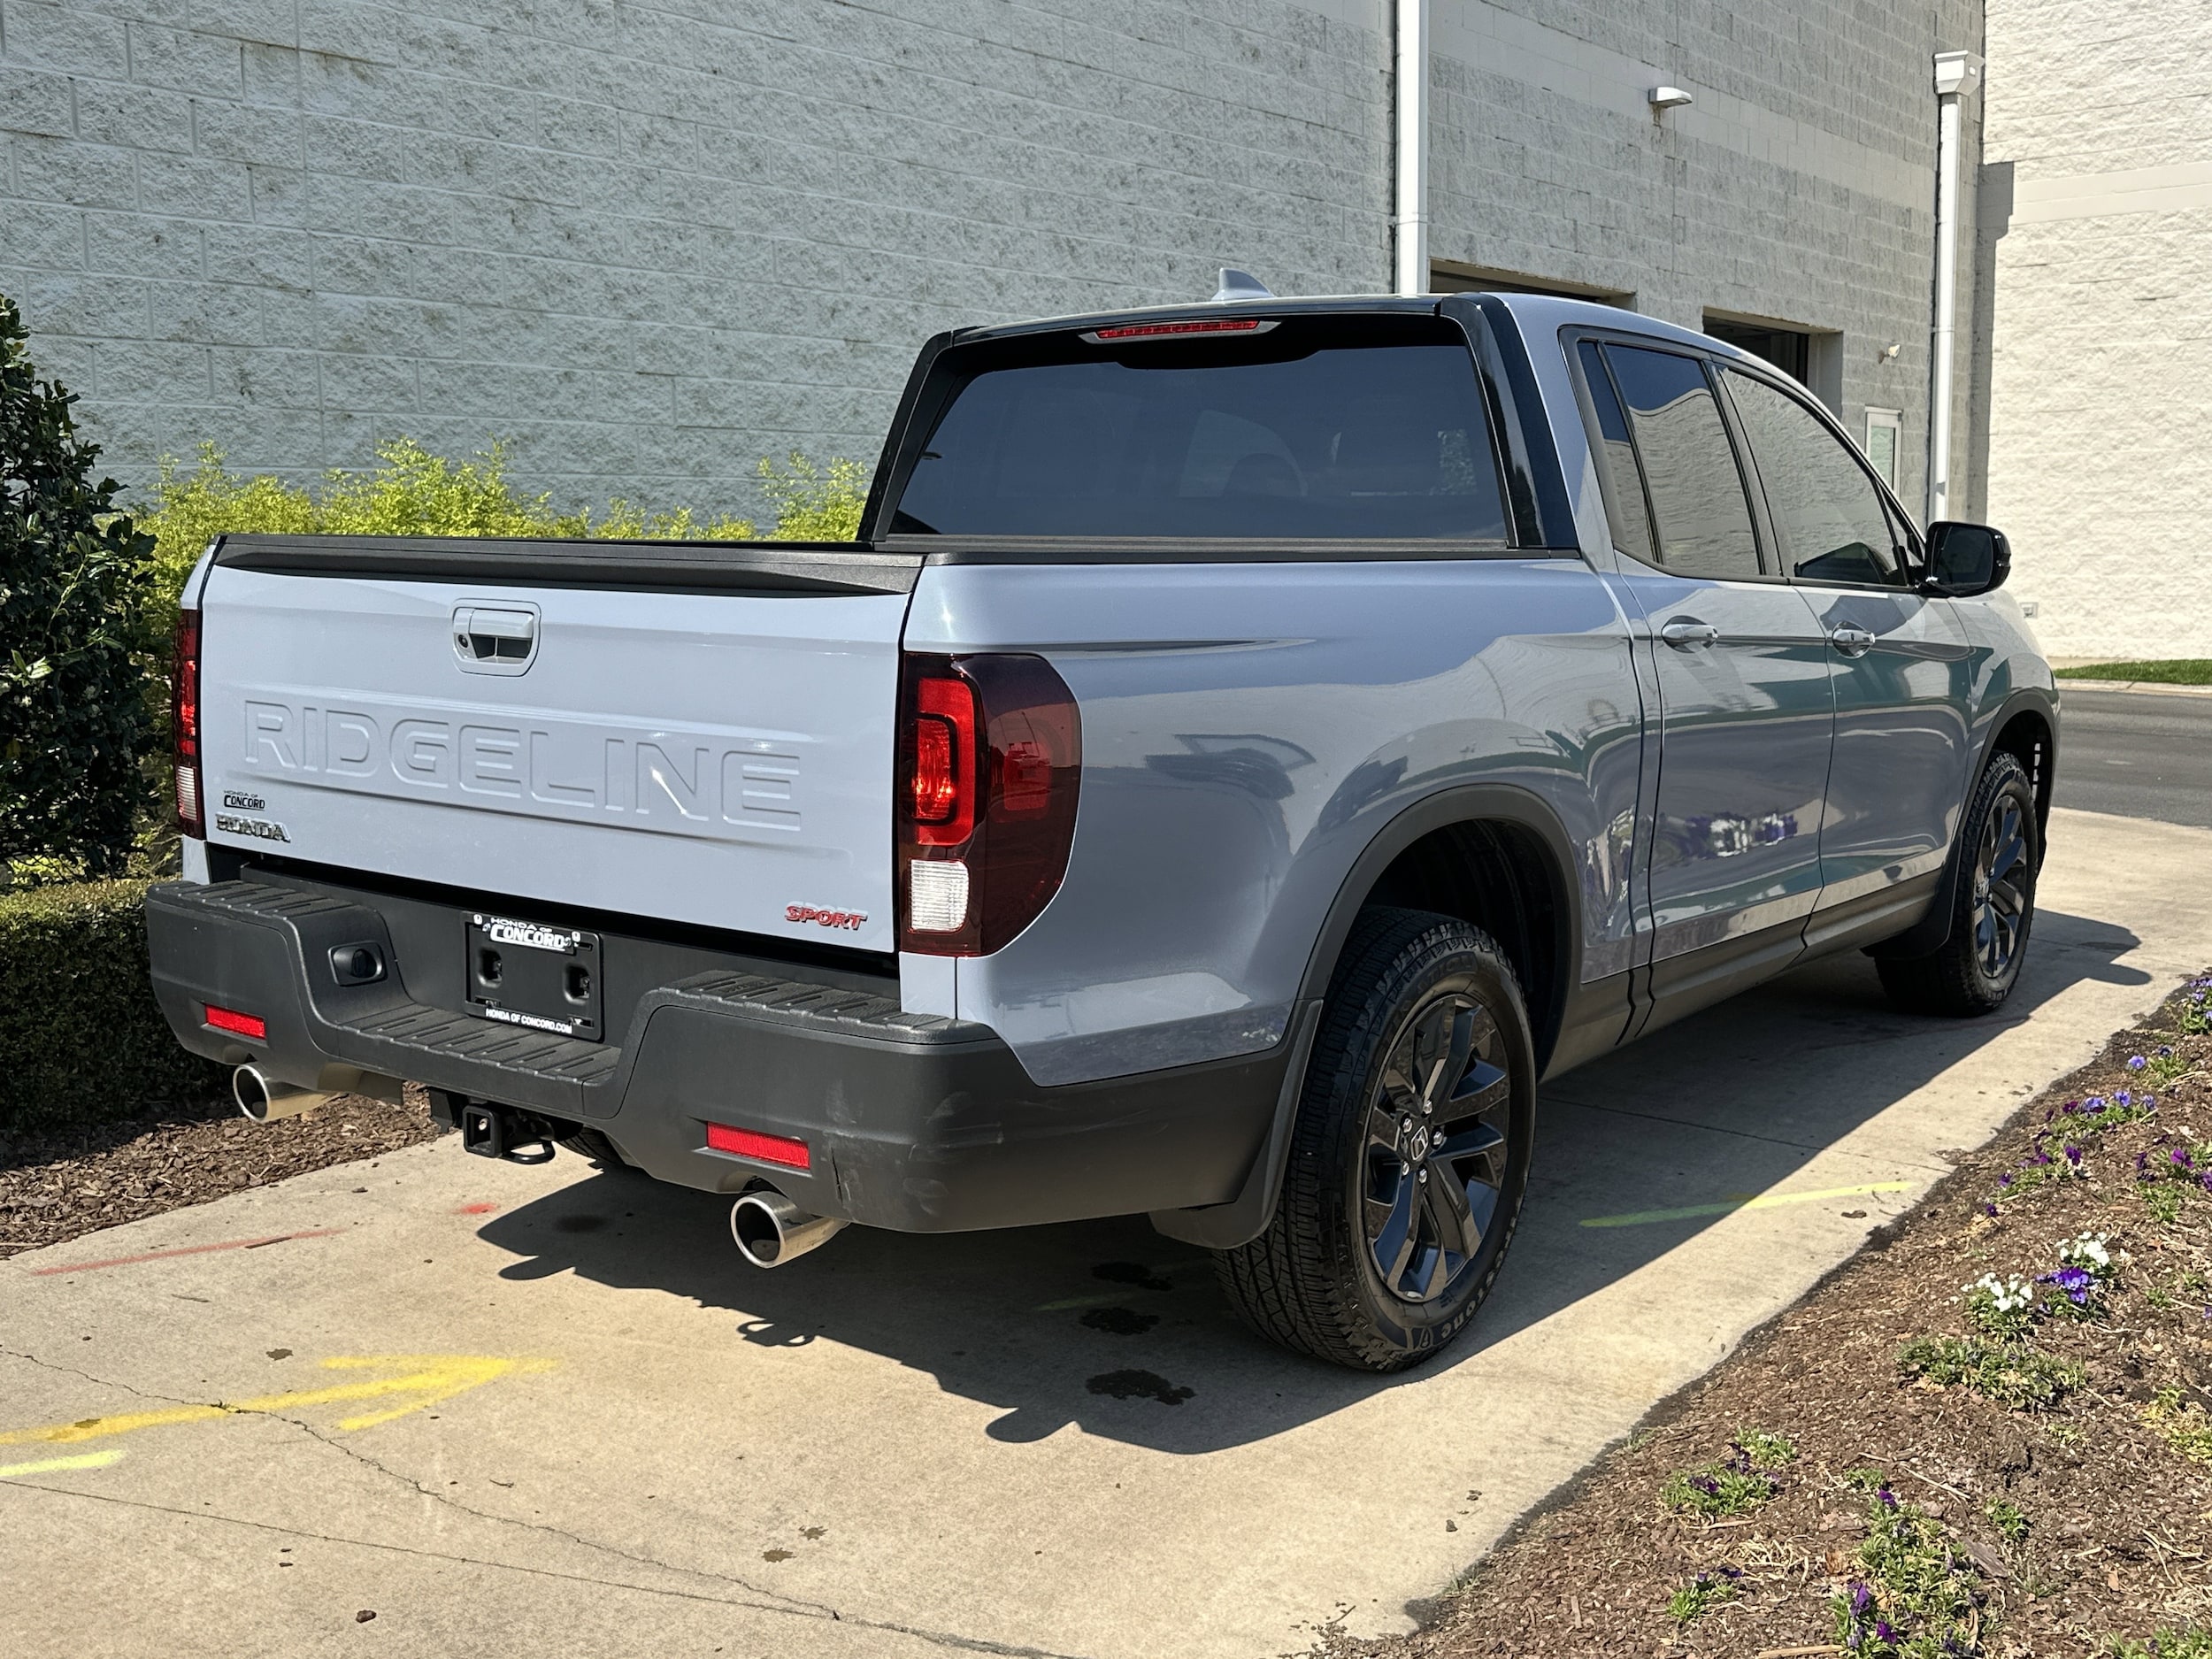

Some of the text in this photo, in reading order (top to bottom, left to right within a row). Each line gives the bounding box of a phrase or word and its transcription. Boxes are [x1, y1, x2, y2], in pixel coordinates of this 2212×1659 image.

[244, 700, 802, 833] RIDGELINE
[224, 795, 265, 811] CONCORD
[216, 811, 291, 842] HONDA
[490, 917, 538, 931] HONDA
[784, 902, 868, 931] SPORT
[490, 924, 565, 951] CONCORD
[485, 1008, 572, 1034] HONDA OF CONCORD.COM
